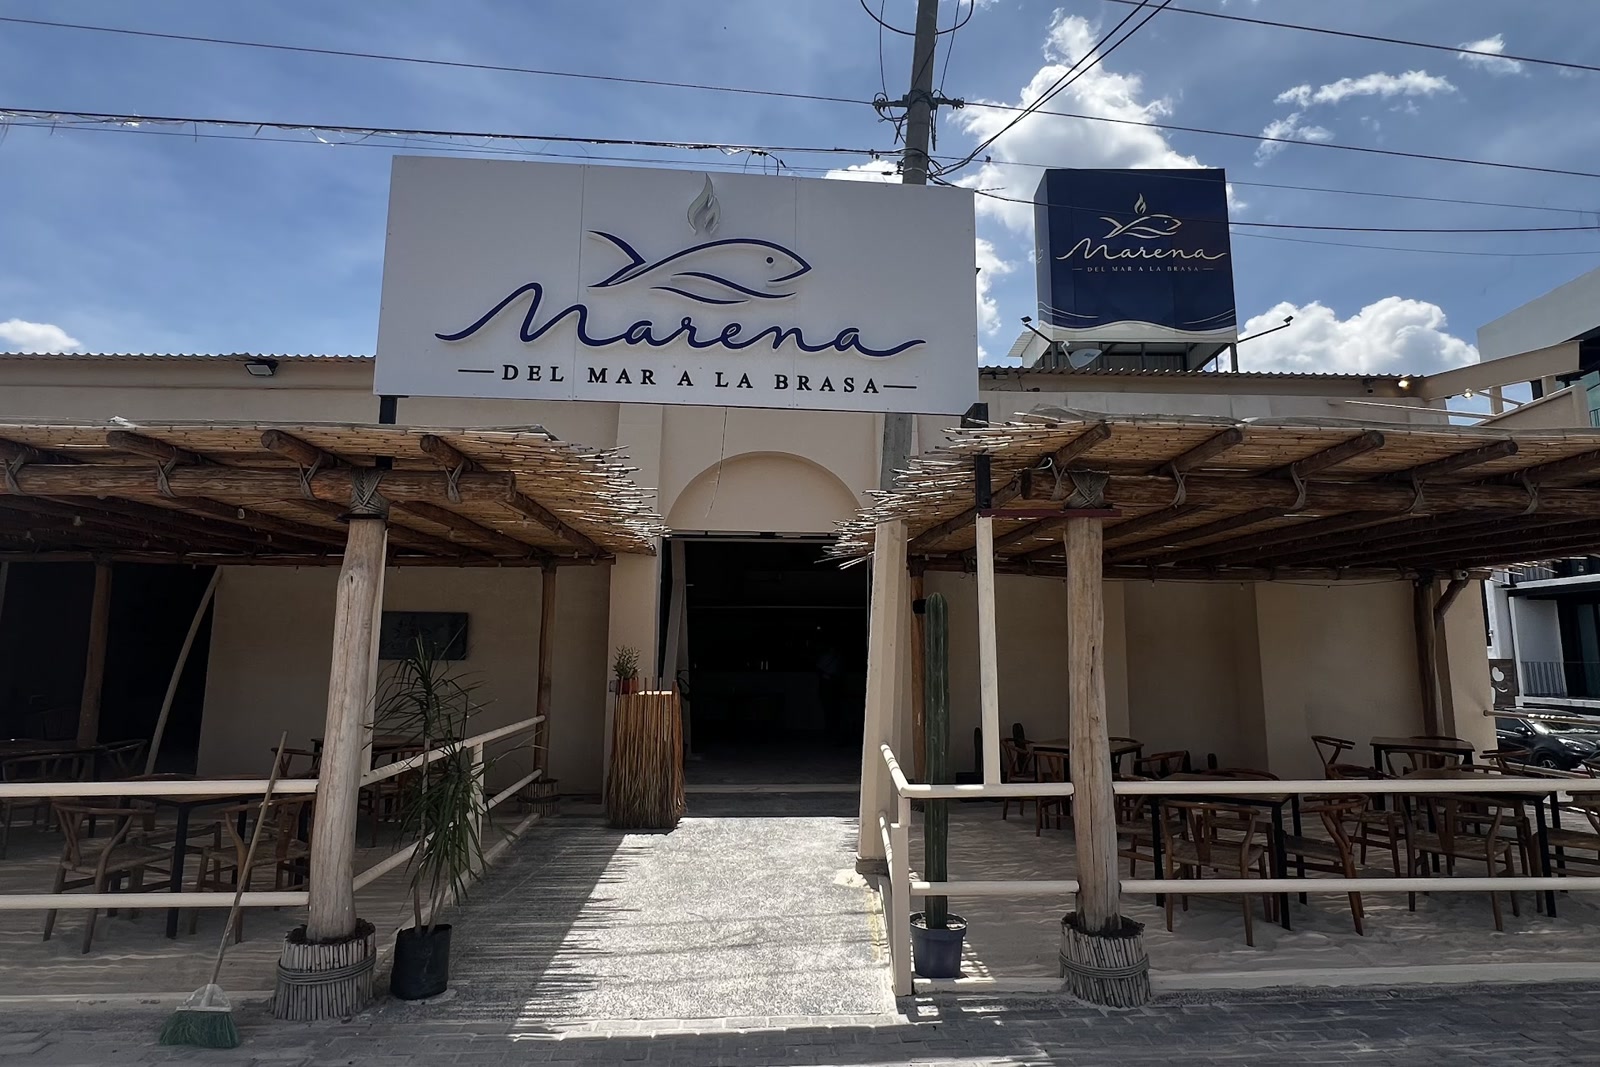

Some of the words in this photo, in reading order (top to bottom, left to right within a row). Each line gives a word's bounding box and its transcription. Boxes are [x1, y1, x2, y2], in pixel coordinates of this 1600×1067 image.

[1056, 237, 1227, 260] Marena
[435, 282, 927, 358] Marena
[501, 364, 565, 383] DEL
[586, 366, 657, 386] MAR
[676, 370, 694, 387] A
[714, 371, 754, 389] LA
[773, 373, 880, 394] BRASA
